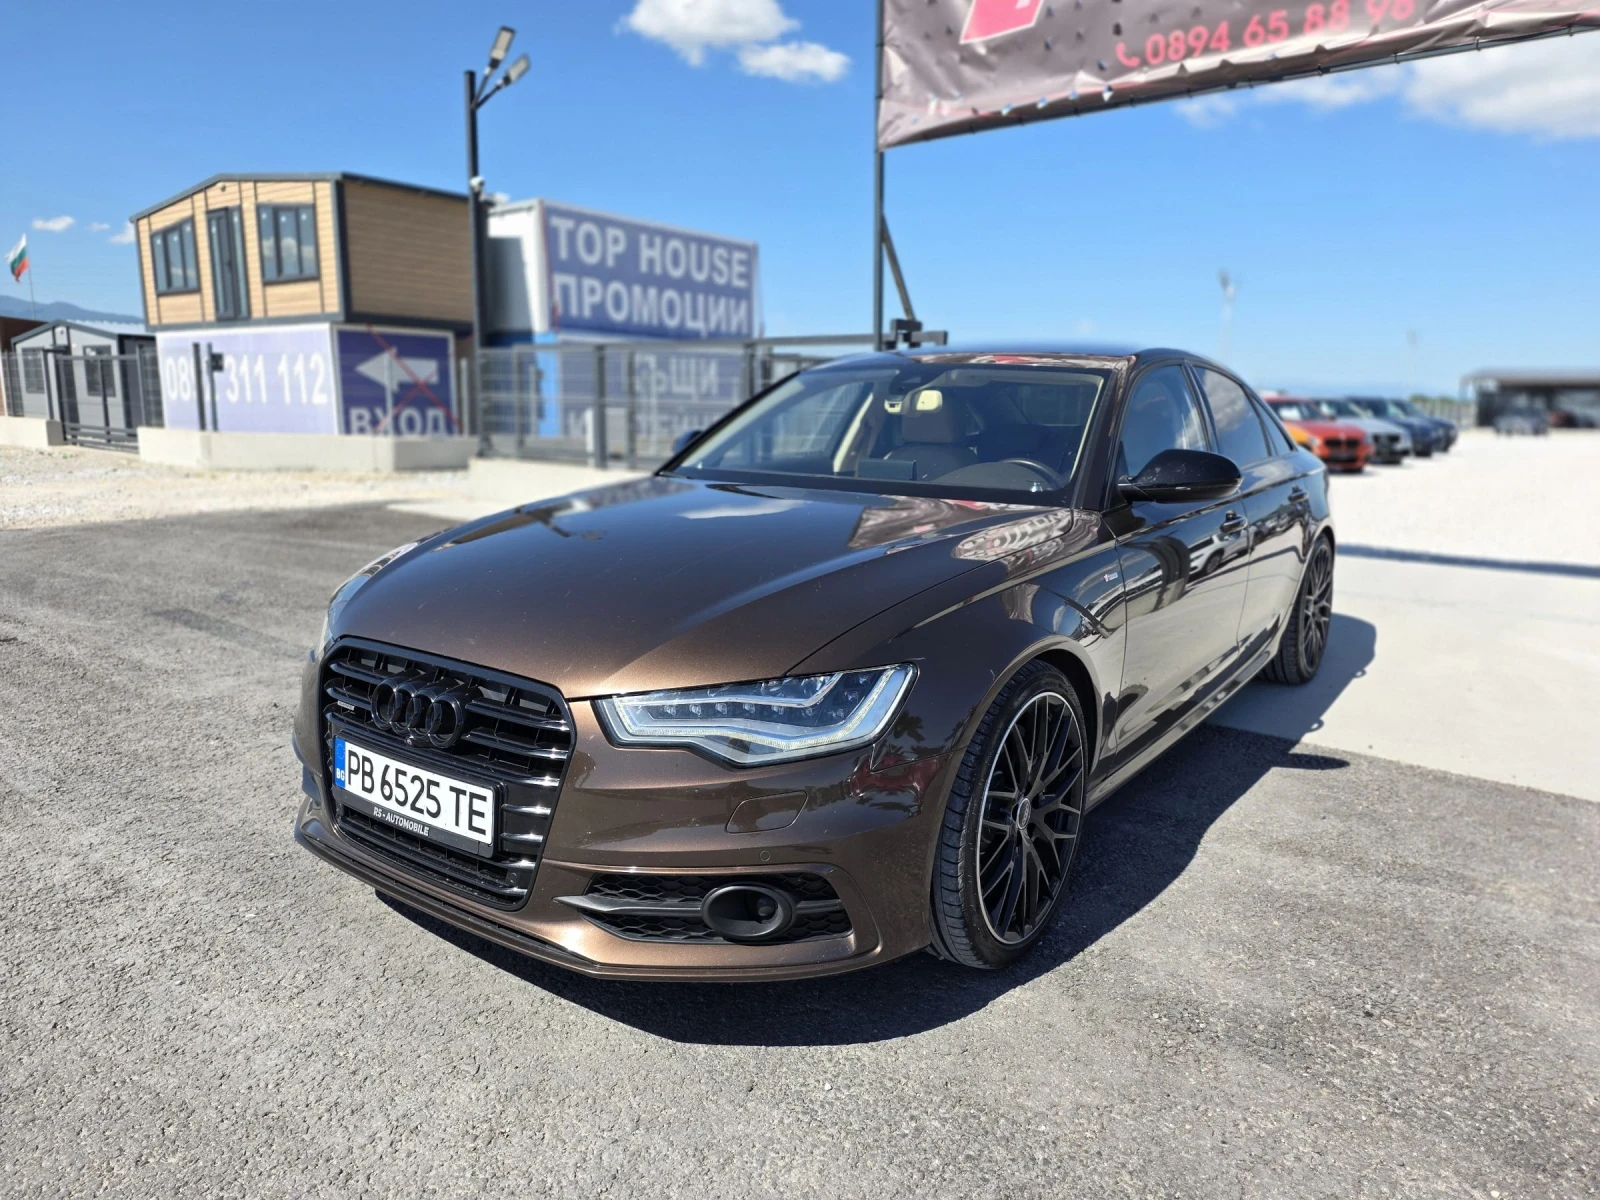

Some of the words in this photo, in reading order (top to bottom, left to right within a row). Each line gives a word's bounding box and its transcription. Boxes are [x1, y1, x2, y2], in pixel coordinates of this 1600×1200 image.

[1145, 20, 1231, 65] 0894
[1243, 9, 1289, 47] 65
[551, 215, 627, 268] TOP
[638, 233, 749, 289] HOUSE
[553, 273, 749, 338] ПРОМОЦИИ
[165, 355, 220, 402] 08
[223, 354, 268, 404] 311
[278, 352, 328, 405] 112
[336, 767, 345, 781] BG
[348, 749, 375, 794] PB
[380, 764, 442, 819] 6525
[449, 785, 487, 836] TE
[373, 806, 382, 818] RS
[386, 812, 430, 836] AUTOMOBILE
